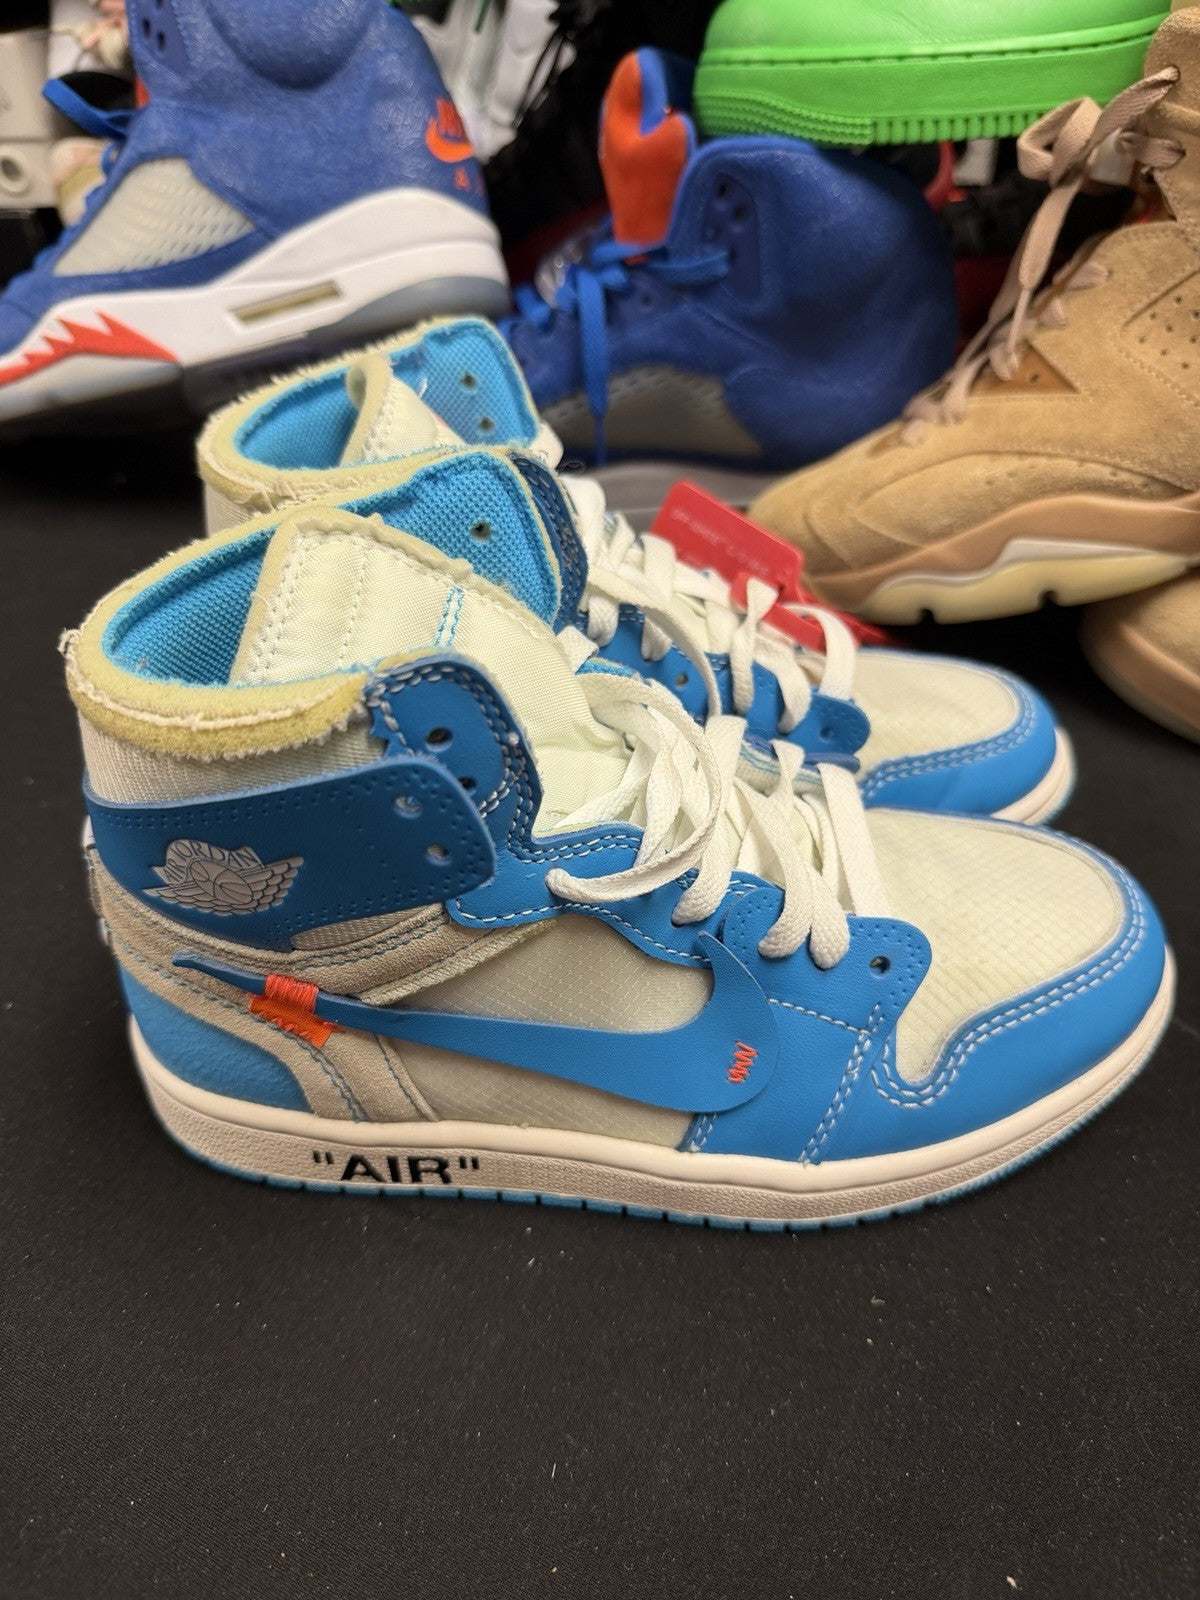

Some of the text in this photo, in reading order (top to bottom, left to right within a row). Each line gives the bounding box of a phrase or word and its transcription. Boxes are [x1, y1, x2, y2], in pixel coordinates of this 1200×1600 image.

[163, 840, 260, 882] AIR JORDAN
[312, 1150, 479, 1184] "AIR"
